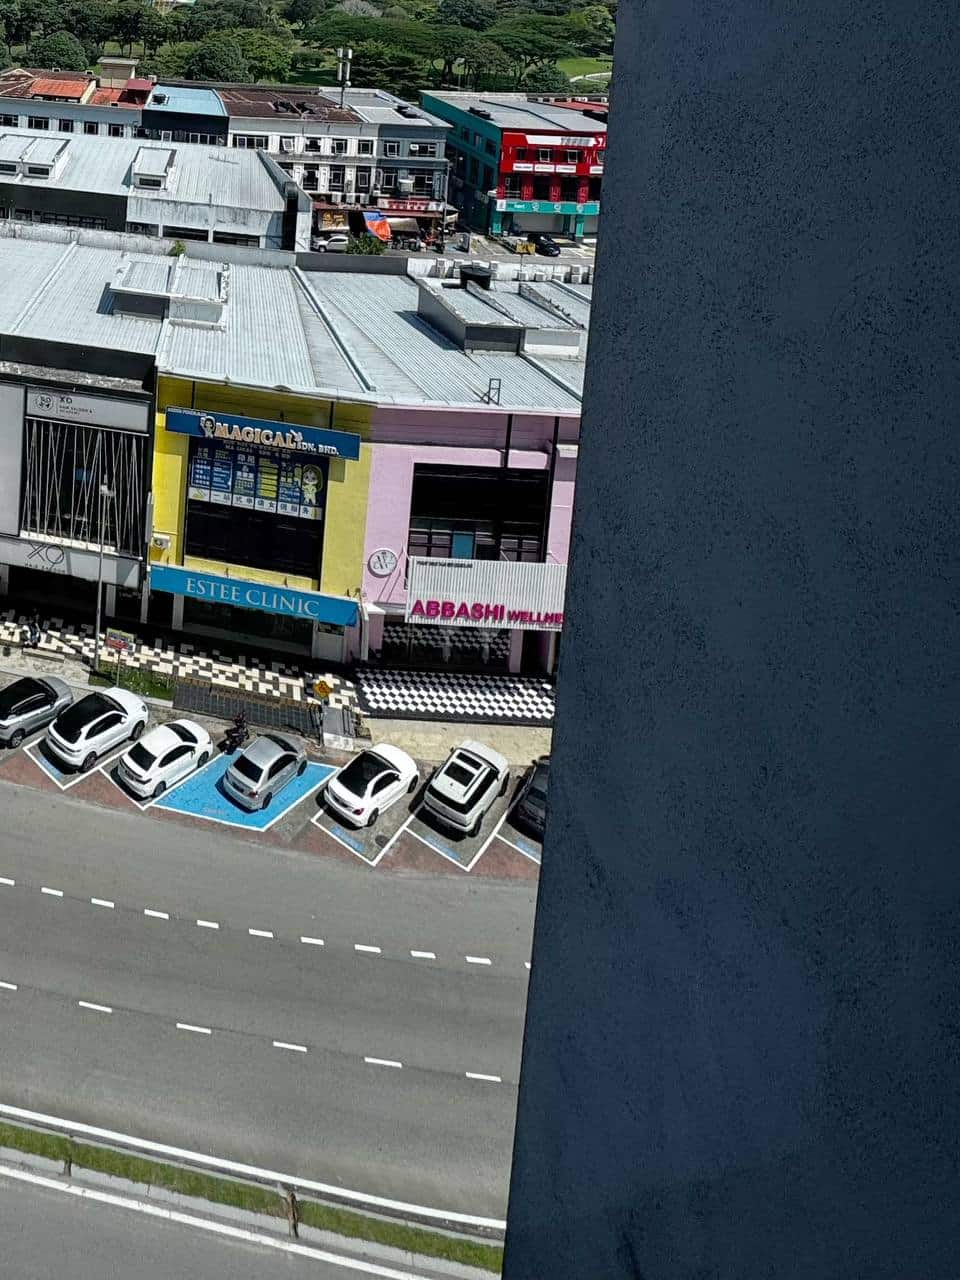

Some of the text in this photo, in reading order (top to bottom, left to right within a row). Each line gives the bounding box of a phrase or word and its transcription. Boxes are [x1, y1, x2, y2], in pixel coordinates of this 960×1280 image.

[214, 422, 297, 450] MAGICAL
[186, 577, 320, 617] ESTEE CLINIC
[411, 599, 505, 621] ABBASHI
